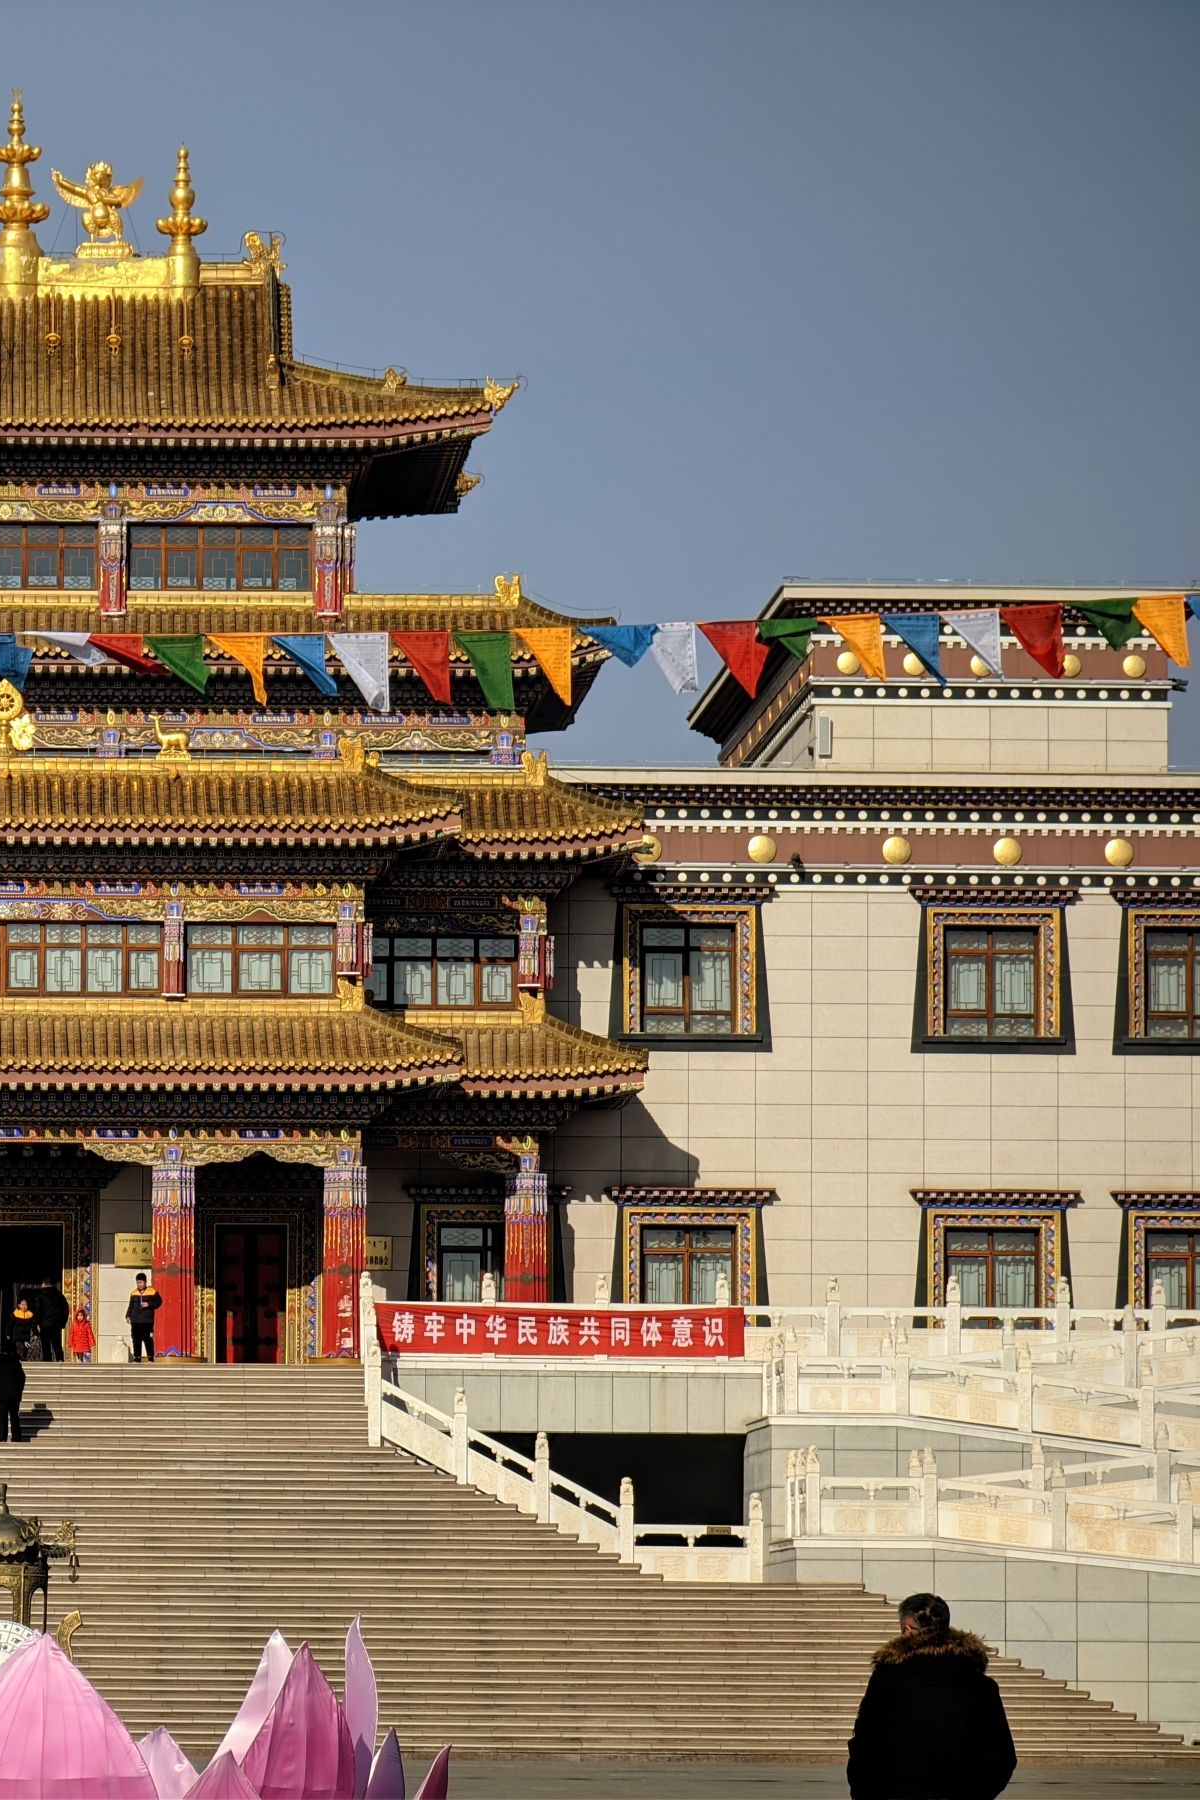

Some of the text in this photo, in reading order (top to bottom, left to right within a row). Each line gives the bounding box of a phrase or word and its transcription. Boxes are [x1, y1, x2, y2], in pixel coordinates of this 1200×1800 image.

[392, 1311, 725, 1348] 铸牢中华民族共同体意识
